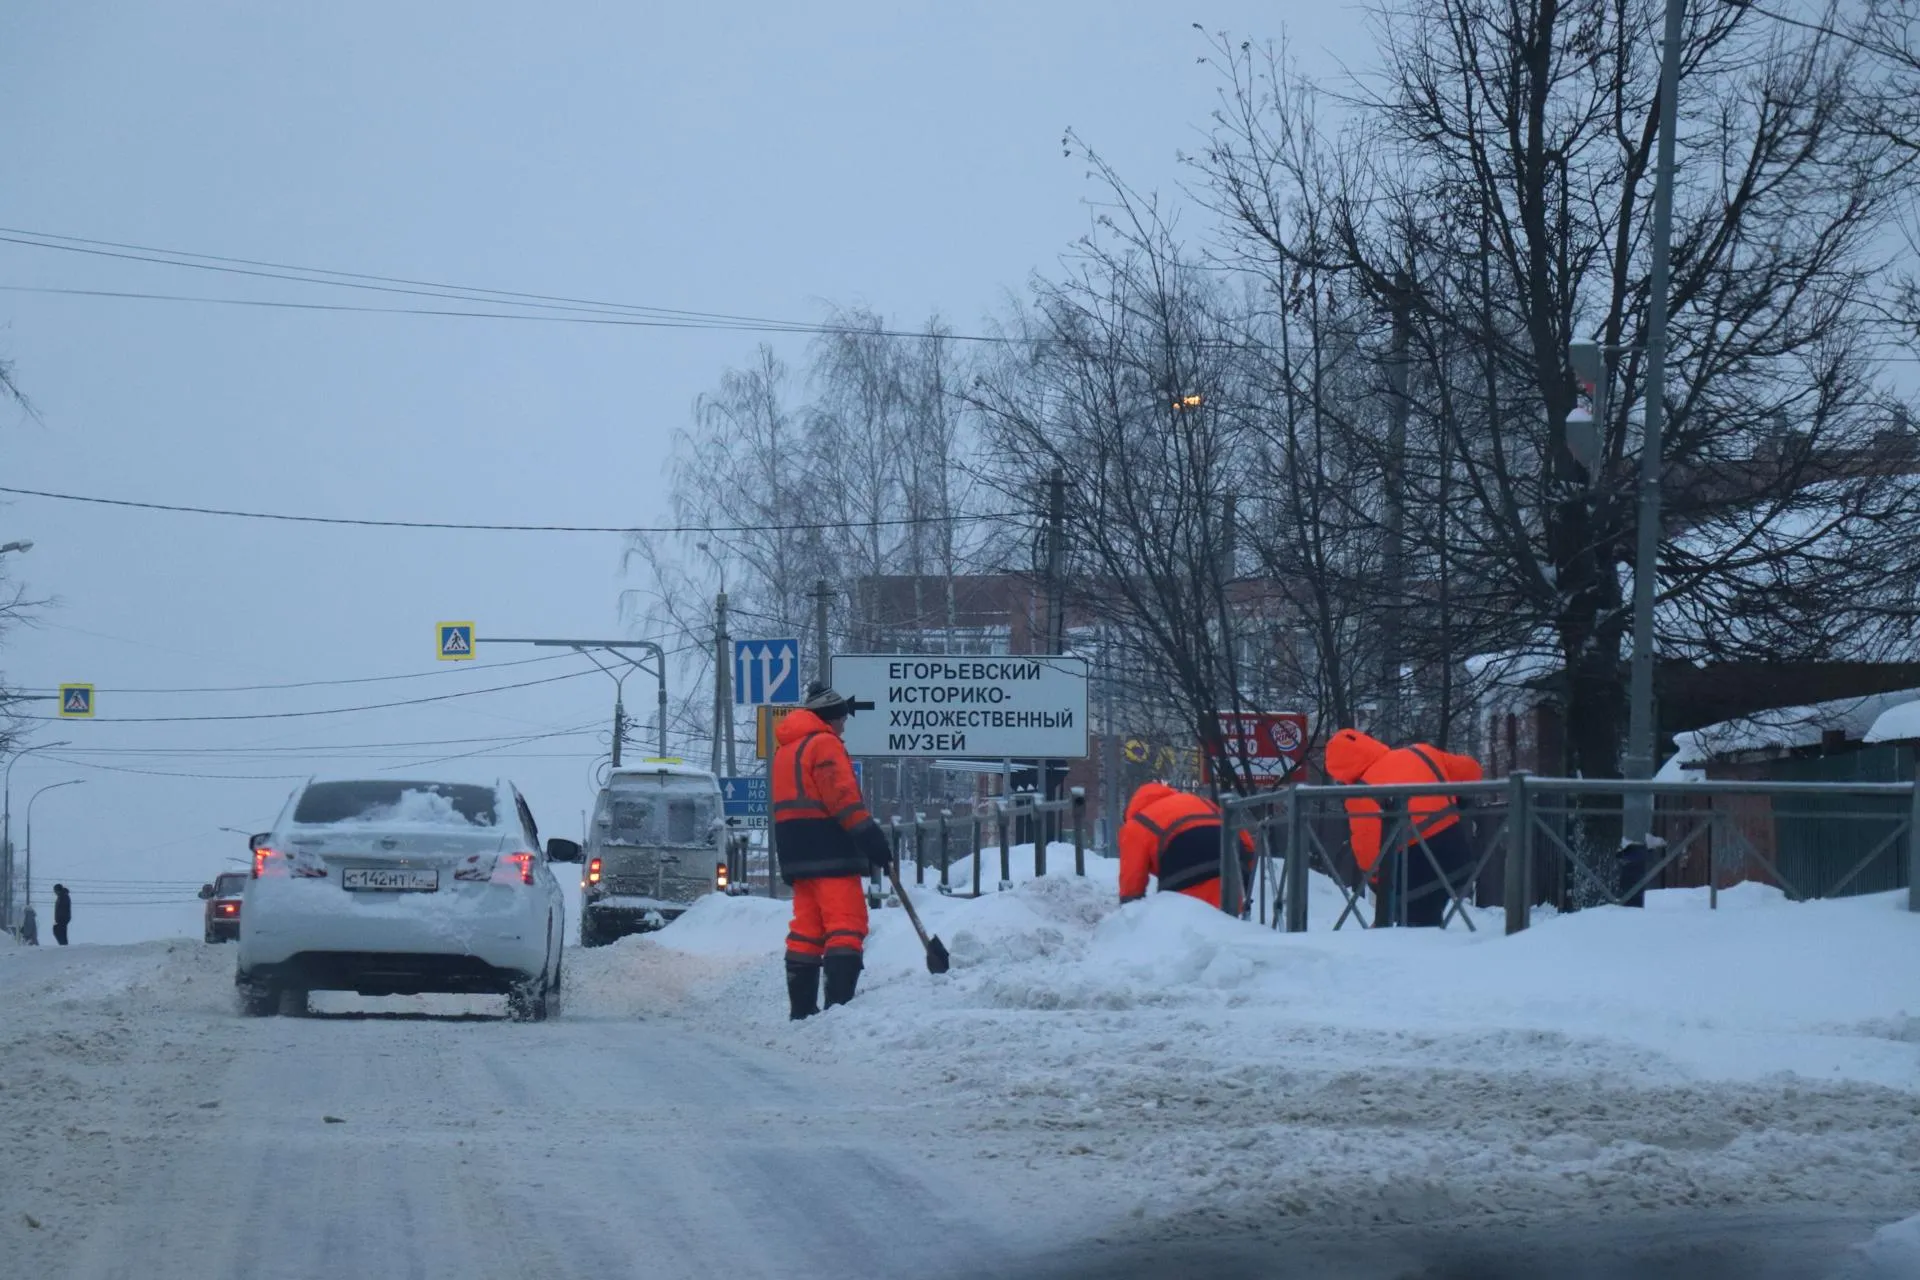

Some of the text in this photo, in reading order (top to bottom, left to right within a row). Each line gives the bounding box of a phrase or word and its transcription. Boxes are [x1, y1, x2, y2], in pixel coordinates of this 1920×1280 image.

[889, 660, 1040, 680] ЕГОРЬЕВСКИЙ
[889, 686, 1011, 703] ИСТОРИКО-
[890, 708, 1073, 730] ХУДОЖЕСТВЕННЫЙ
[888, 731, 966, 750] МУЗЕЙ
[747, 780, 767, 789] ША
[747, 790, 766, 799] МО
